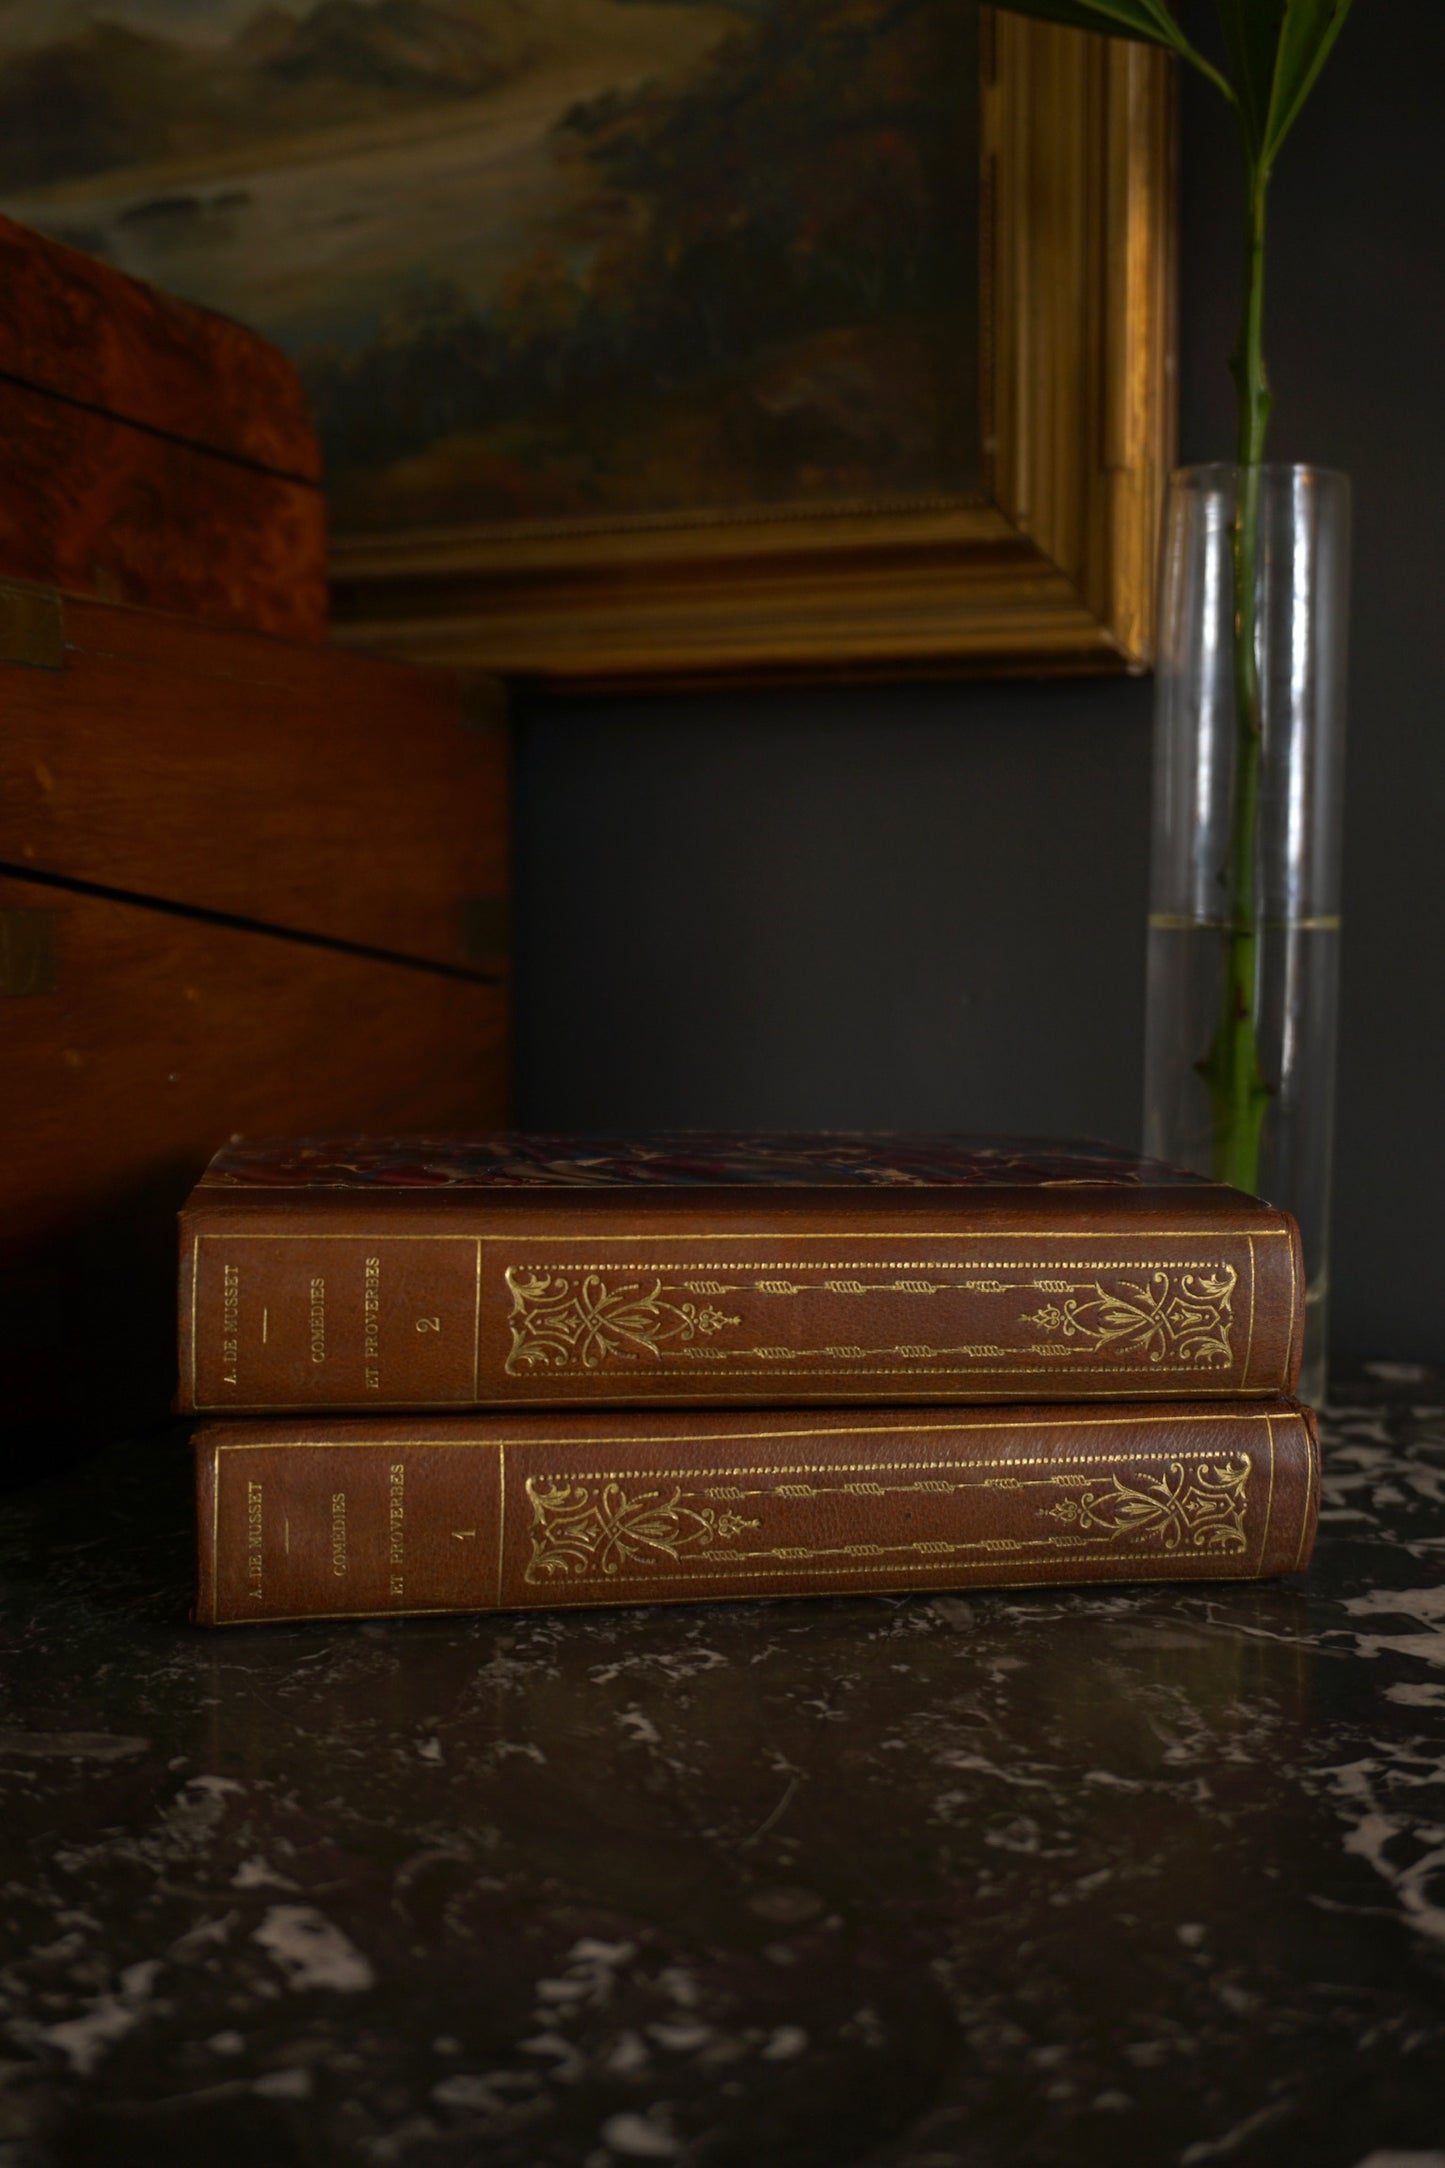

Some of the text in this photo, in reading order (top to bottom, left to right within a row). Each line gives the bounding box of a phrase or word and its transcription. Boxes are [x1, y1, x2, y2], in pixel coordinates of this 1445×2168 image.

[223, 1264, 239, 1385] A. DE MUSSET
[365, 1256, 380, 1389] ET PROVERBES
[415, 1316, 441, 1333] 2
[248, 1480, 263, 1599] A. DE MUSSET
[390, 1463, 405, 1595] ET PROVERBES
[451, 1528, 476, 1541] 1
